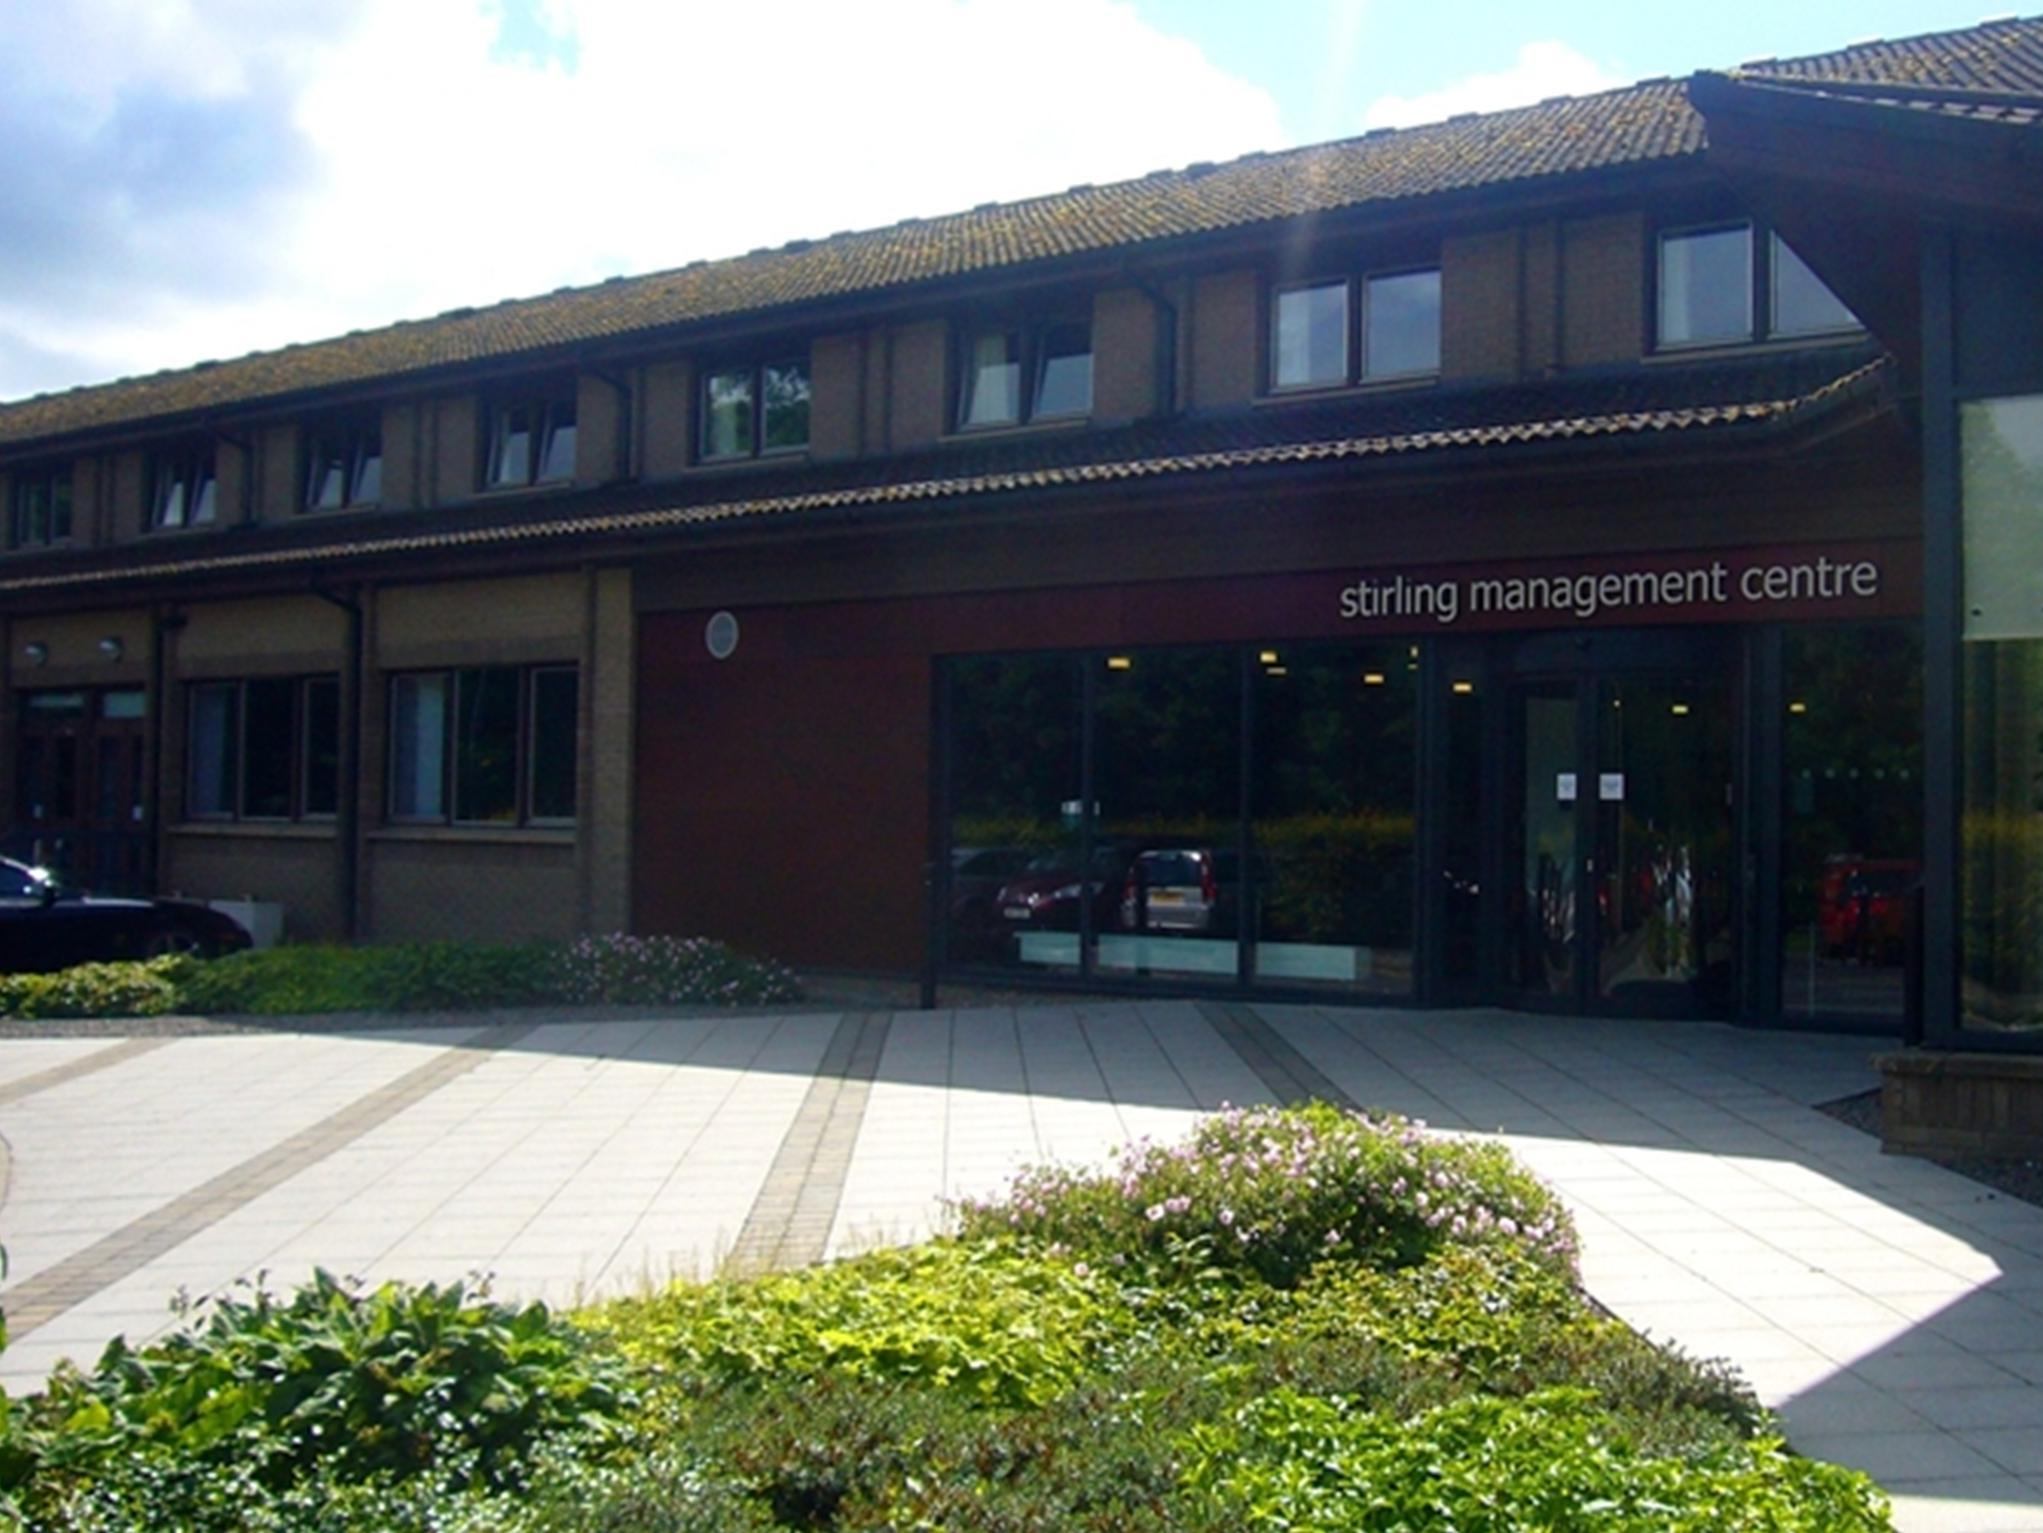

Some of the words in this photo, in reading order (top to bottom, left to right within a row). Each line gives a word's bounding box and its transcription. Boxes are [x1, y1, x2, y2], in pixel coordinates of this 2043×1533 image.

[1340, 575, 1458, 623] stirling
[1470, 561, 1727, 617] management
[1740, 556, 1878, 600] centre
